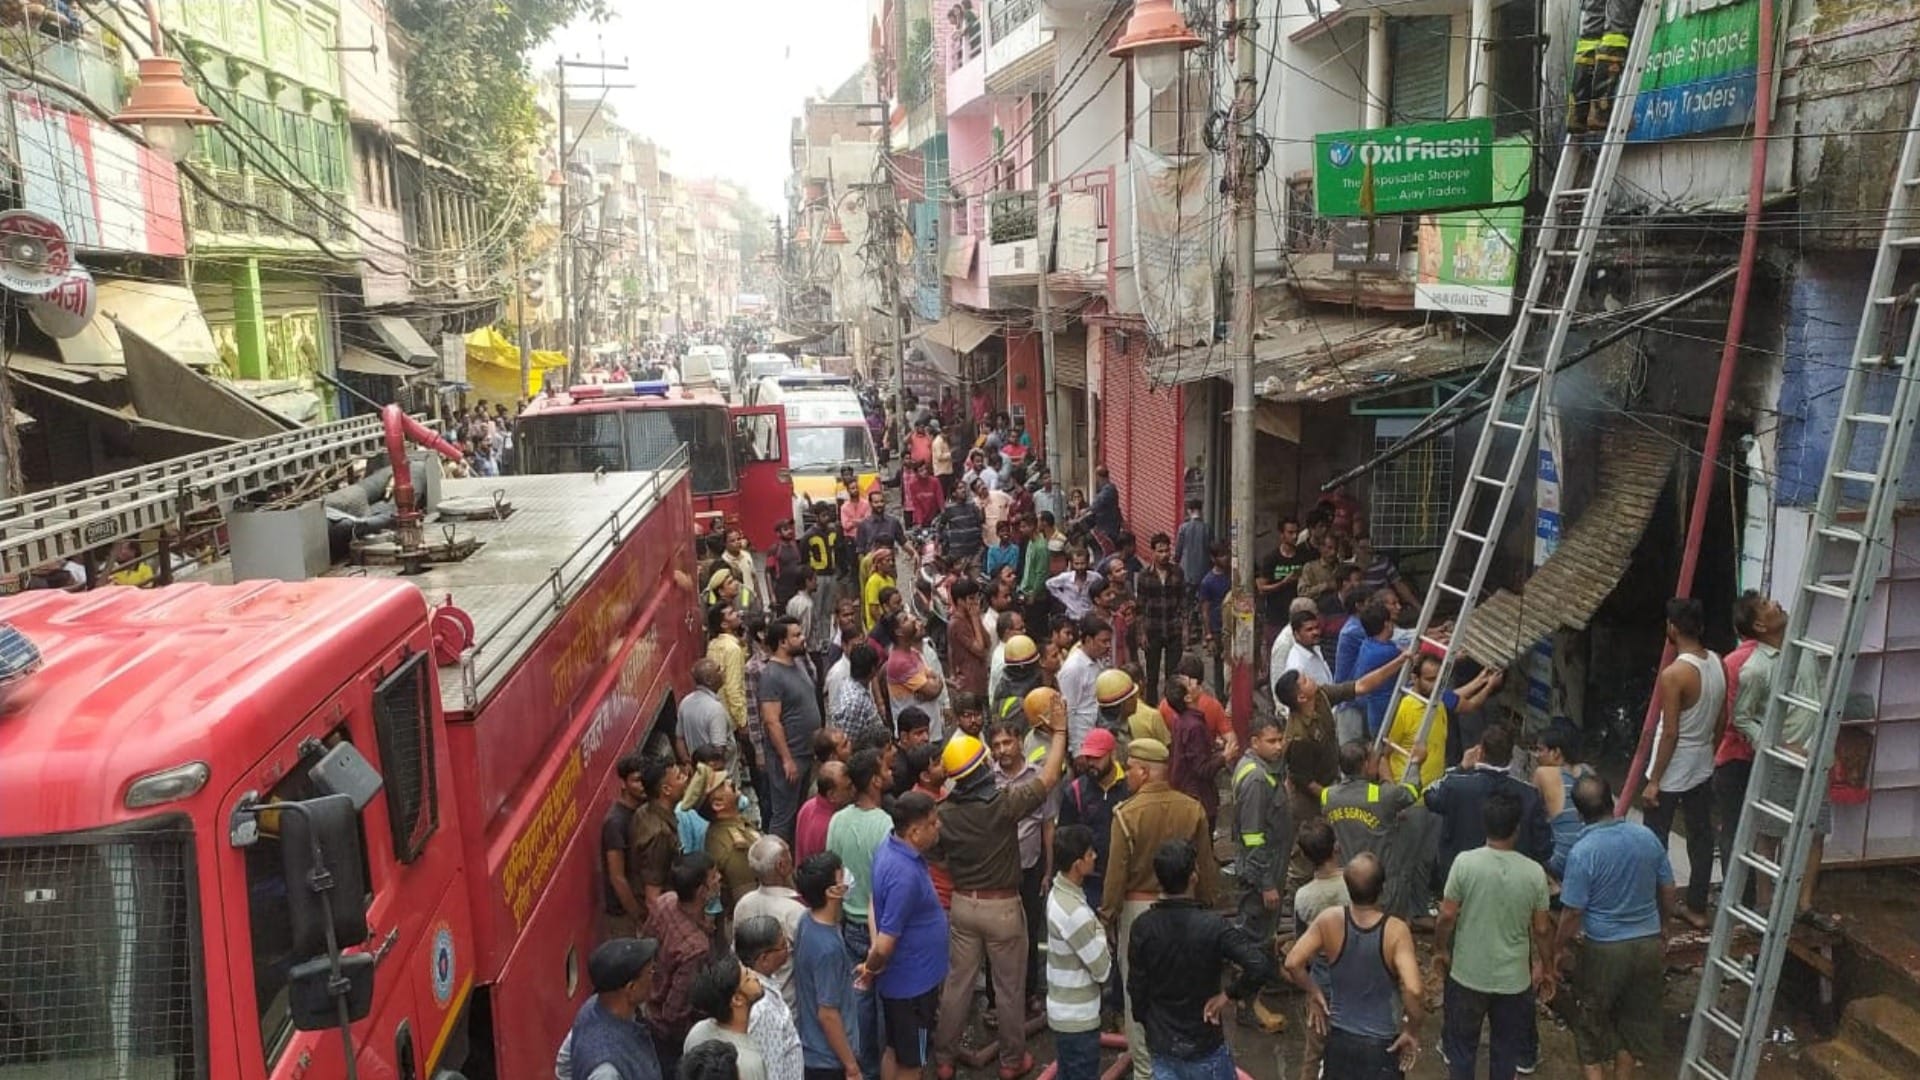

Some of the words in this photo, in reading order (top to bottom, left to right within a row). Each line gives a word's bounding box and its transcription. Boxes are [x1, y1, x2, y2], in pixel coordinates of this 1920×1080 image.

[1689, 29, 1749, 62] Shoppe
[1645, 96, 1677, 122] Ajay
[1681, 85, 1737, 114] Traders
[1343, 178, 1360, 188] The
[1371, 170, 1424, 187] sposable
[1428, 168, 1471, 182] Shoppe
[1399, 189, 1424, 201] Ajay
[1428, 185, 1467, 197] Traders
